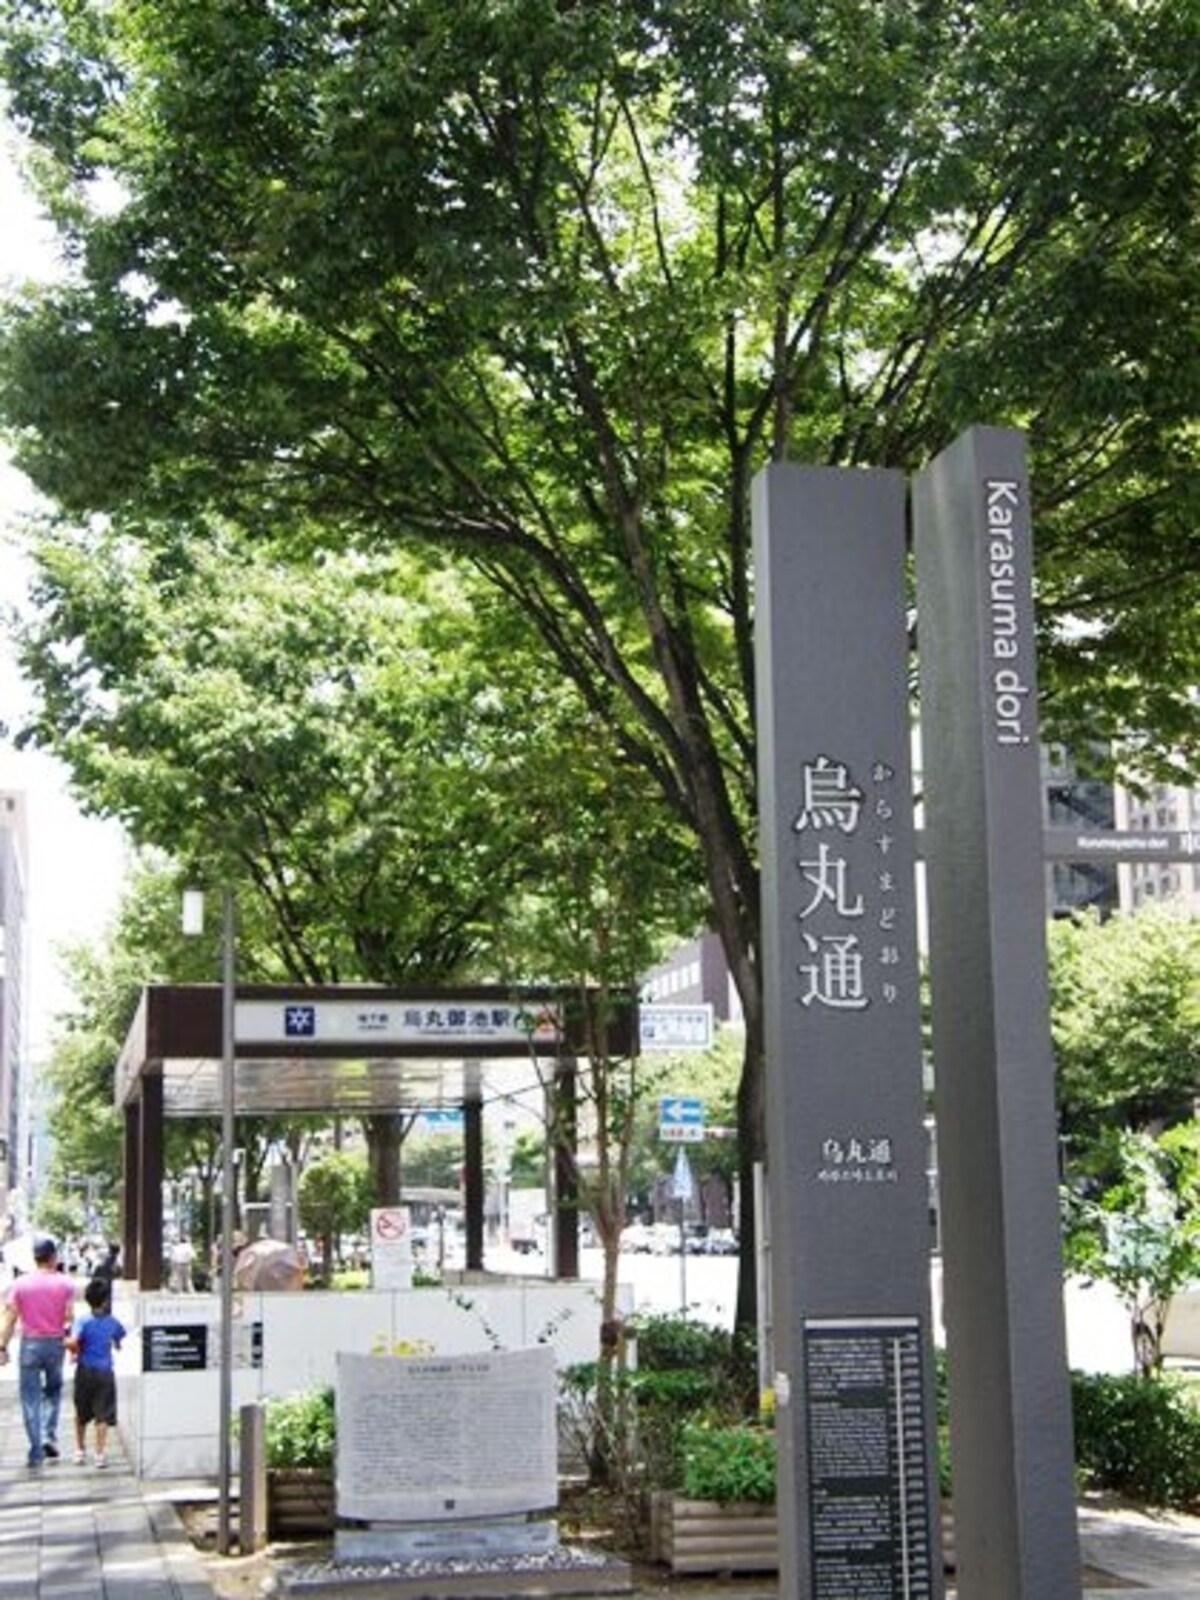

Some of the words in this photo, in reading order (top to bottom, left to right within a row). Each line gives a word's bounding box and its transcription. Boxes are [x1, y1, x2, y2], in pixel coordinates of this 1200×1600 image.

[986, 480, 1019, 659] Karasuma
[994, 669, 1030, 744] dori
[795, 756, 868, 1008] 烏丸通
[872, 763, 899, 1003] からすまどおり
